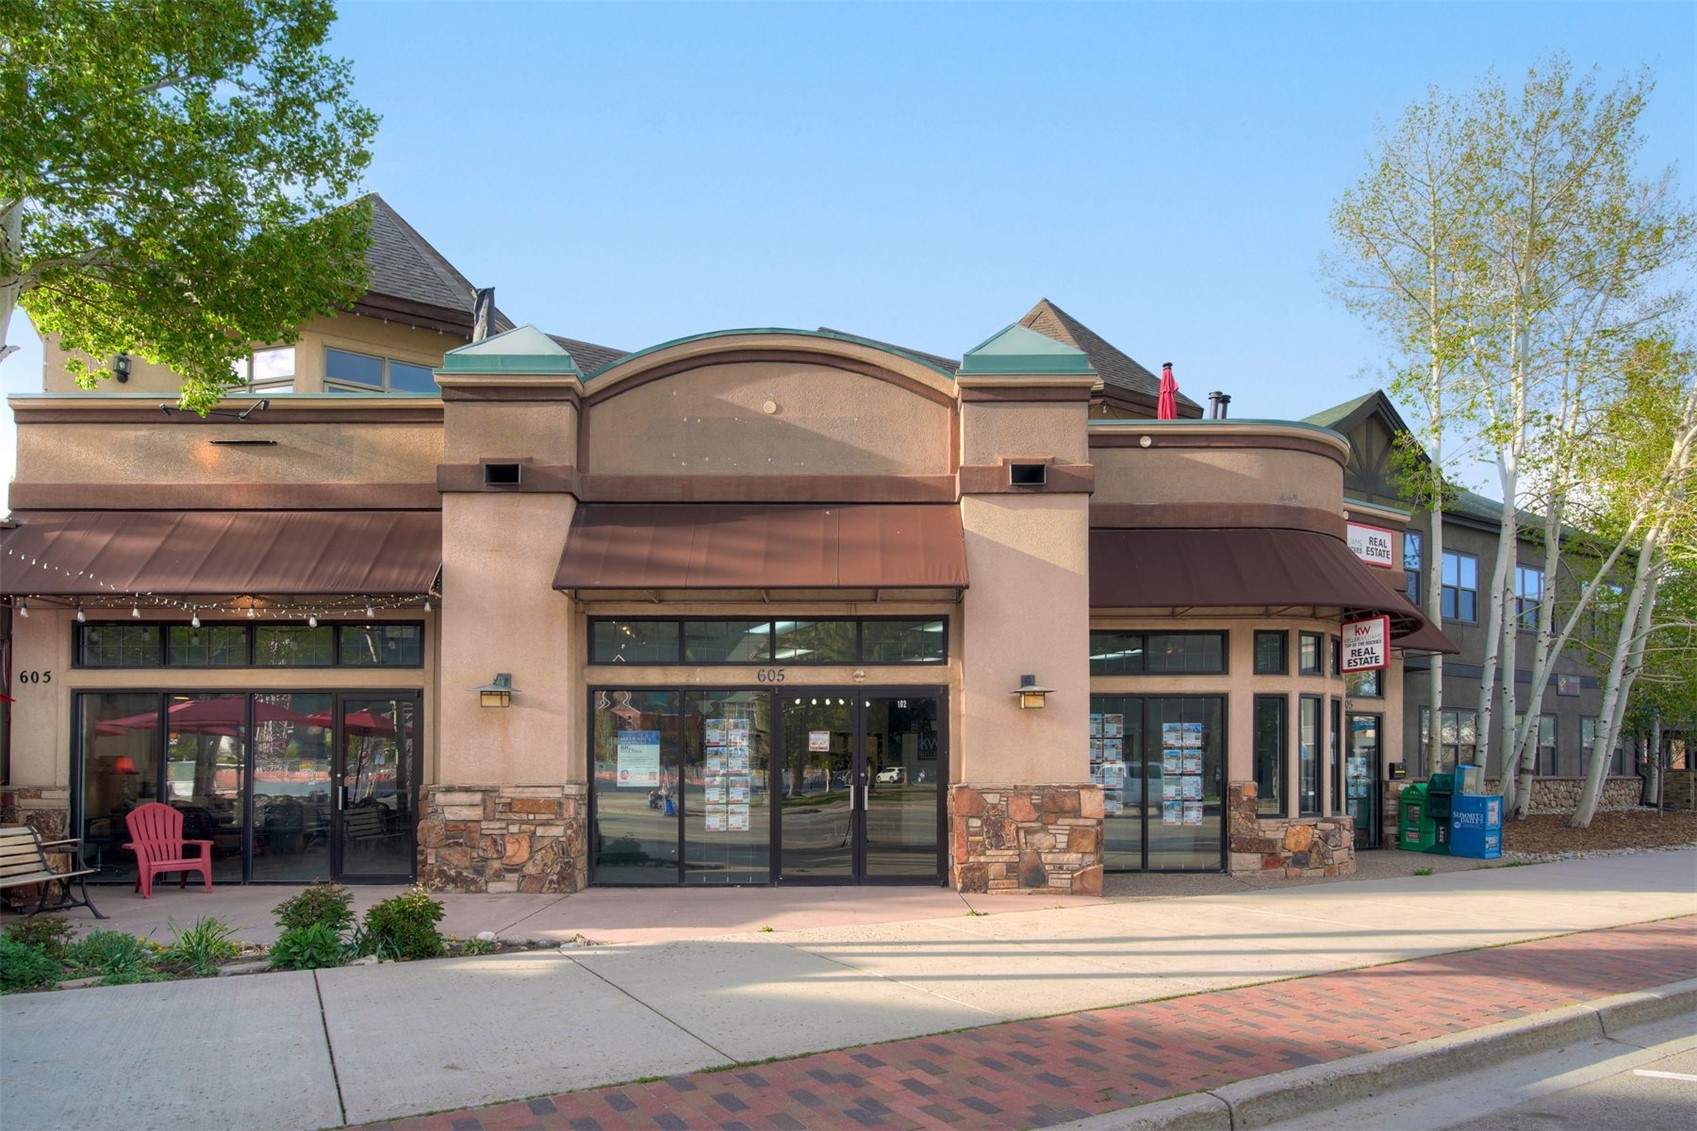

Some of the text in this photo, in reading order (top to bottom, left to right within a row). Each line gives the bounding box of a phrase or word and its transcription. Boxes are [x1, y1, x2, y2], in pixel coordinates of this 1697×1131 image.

[1368, 536, 1388, 549] REAL
[1365, 546, 1391, 560] ESTATE
[1350, 647, 1376, 658] REAL
[1347, 655, 1381, 668] ESTATE
[20, 670, 52, 684] 605
[757, 669, 785, 682] 605
[1345, 699, 1354, 710] 05
[1453, 811, 1480, 819] SUMMIT
